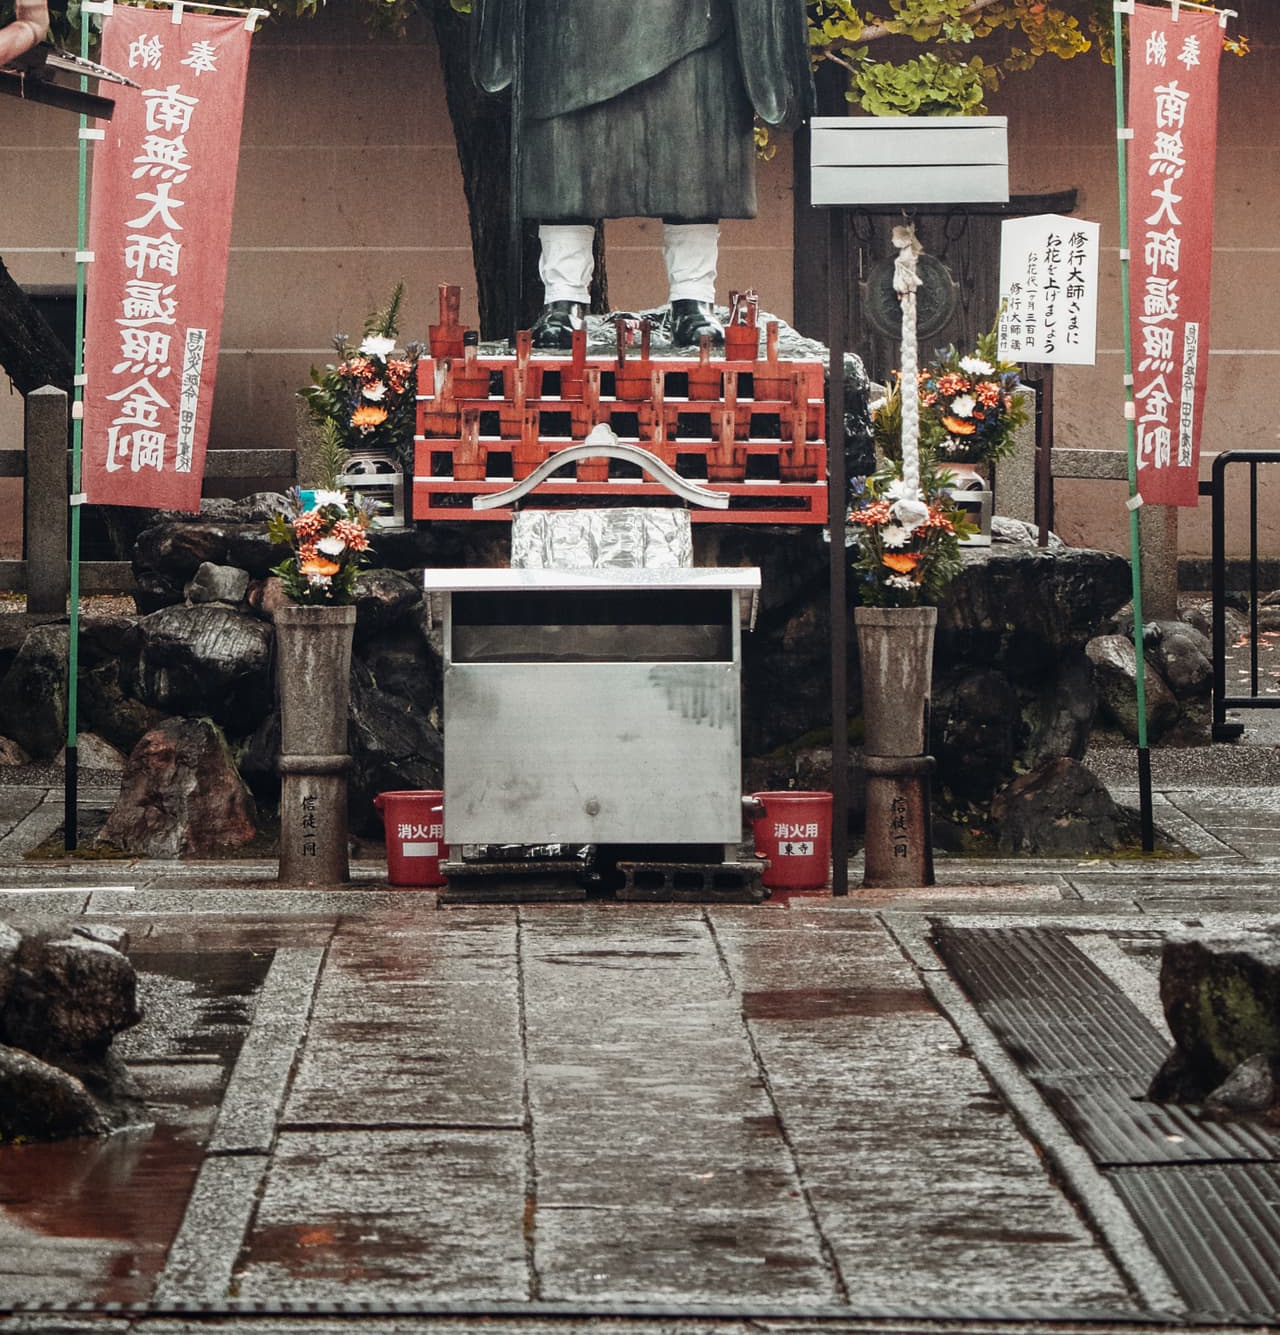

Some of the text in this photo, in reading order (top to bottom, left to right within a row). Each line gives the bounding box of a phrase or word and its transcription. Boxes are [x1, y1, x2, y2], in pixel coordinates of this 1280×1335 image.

[1043, 232, 1062, 354] お花を上げましょう
[1066, 231, 1089, 345] 修行大師さまに
[1000, 297, 1009, 350] 21日受付
[302, 795, 318, 857] 信徒一同
[397, 824, 444, 839] 消火用
[774, 823, 819, 838] 消火用
[784, 843, 809, 856] 東寺
[891, 796, 910, 858] 信徒一同
